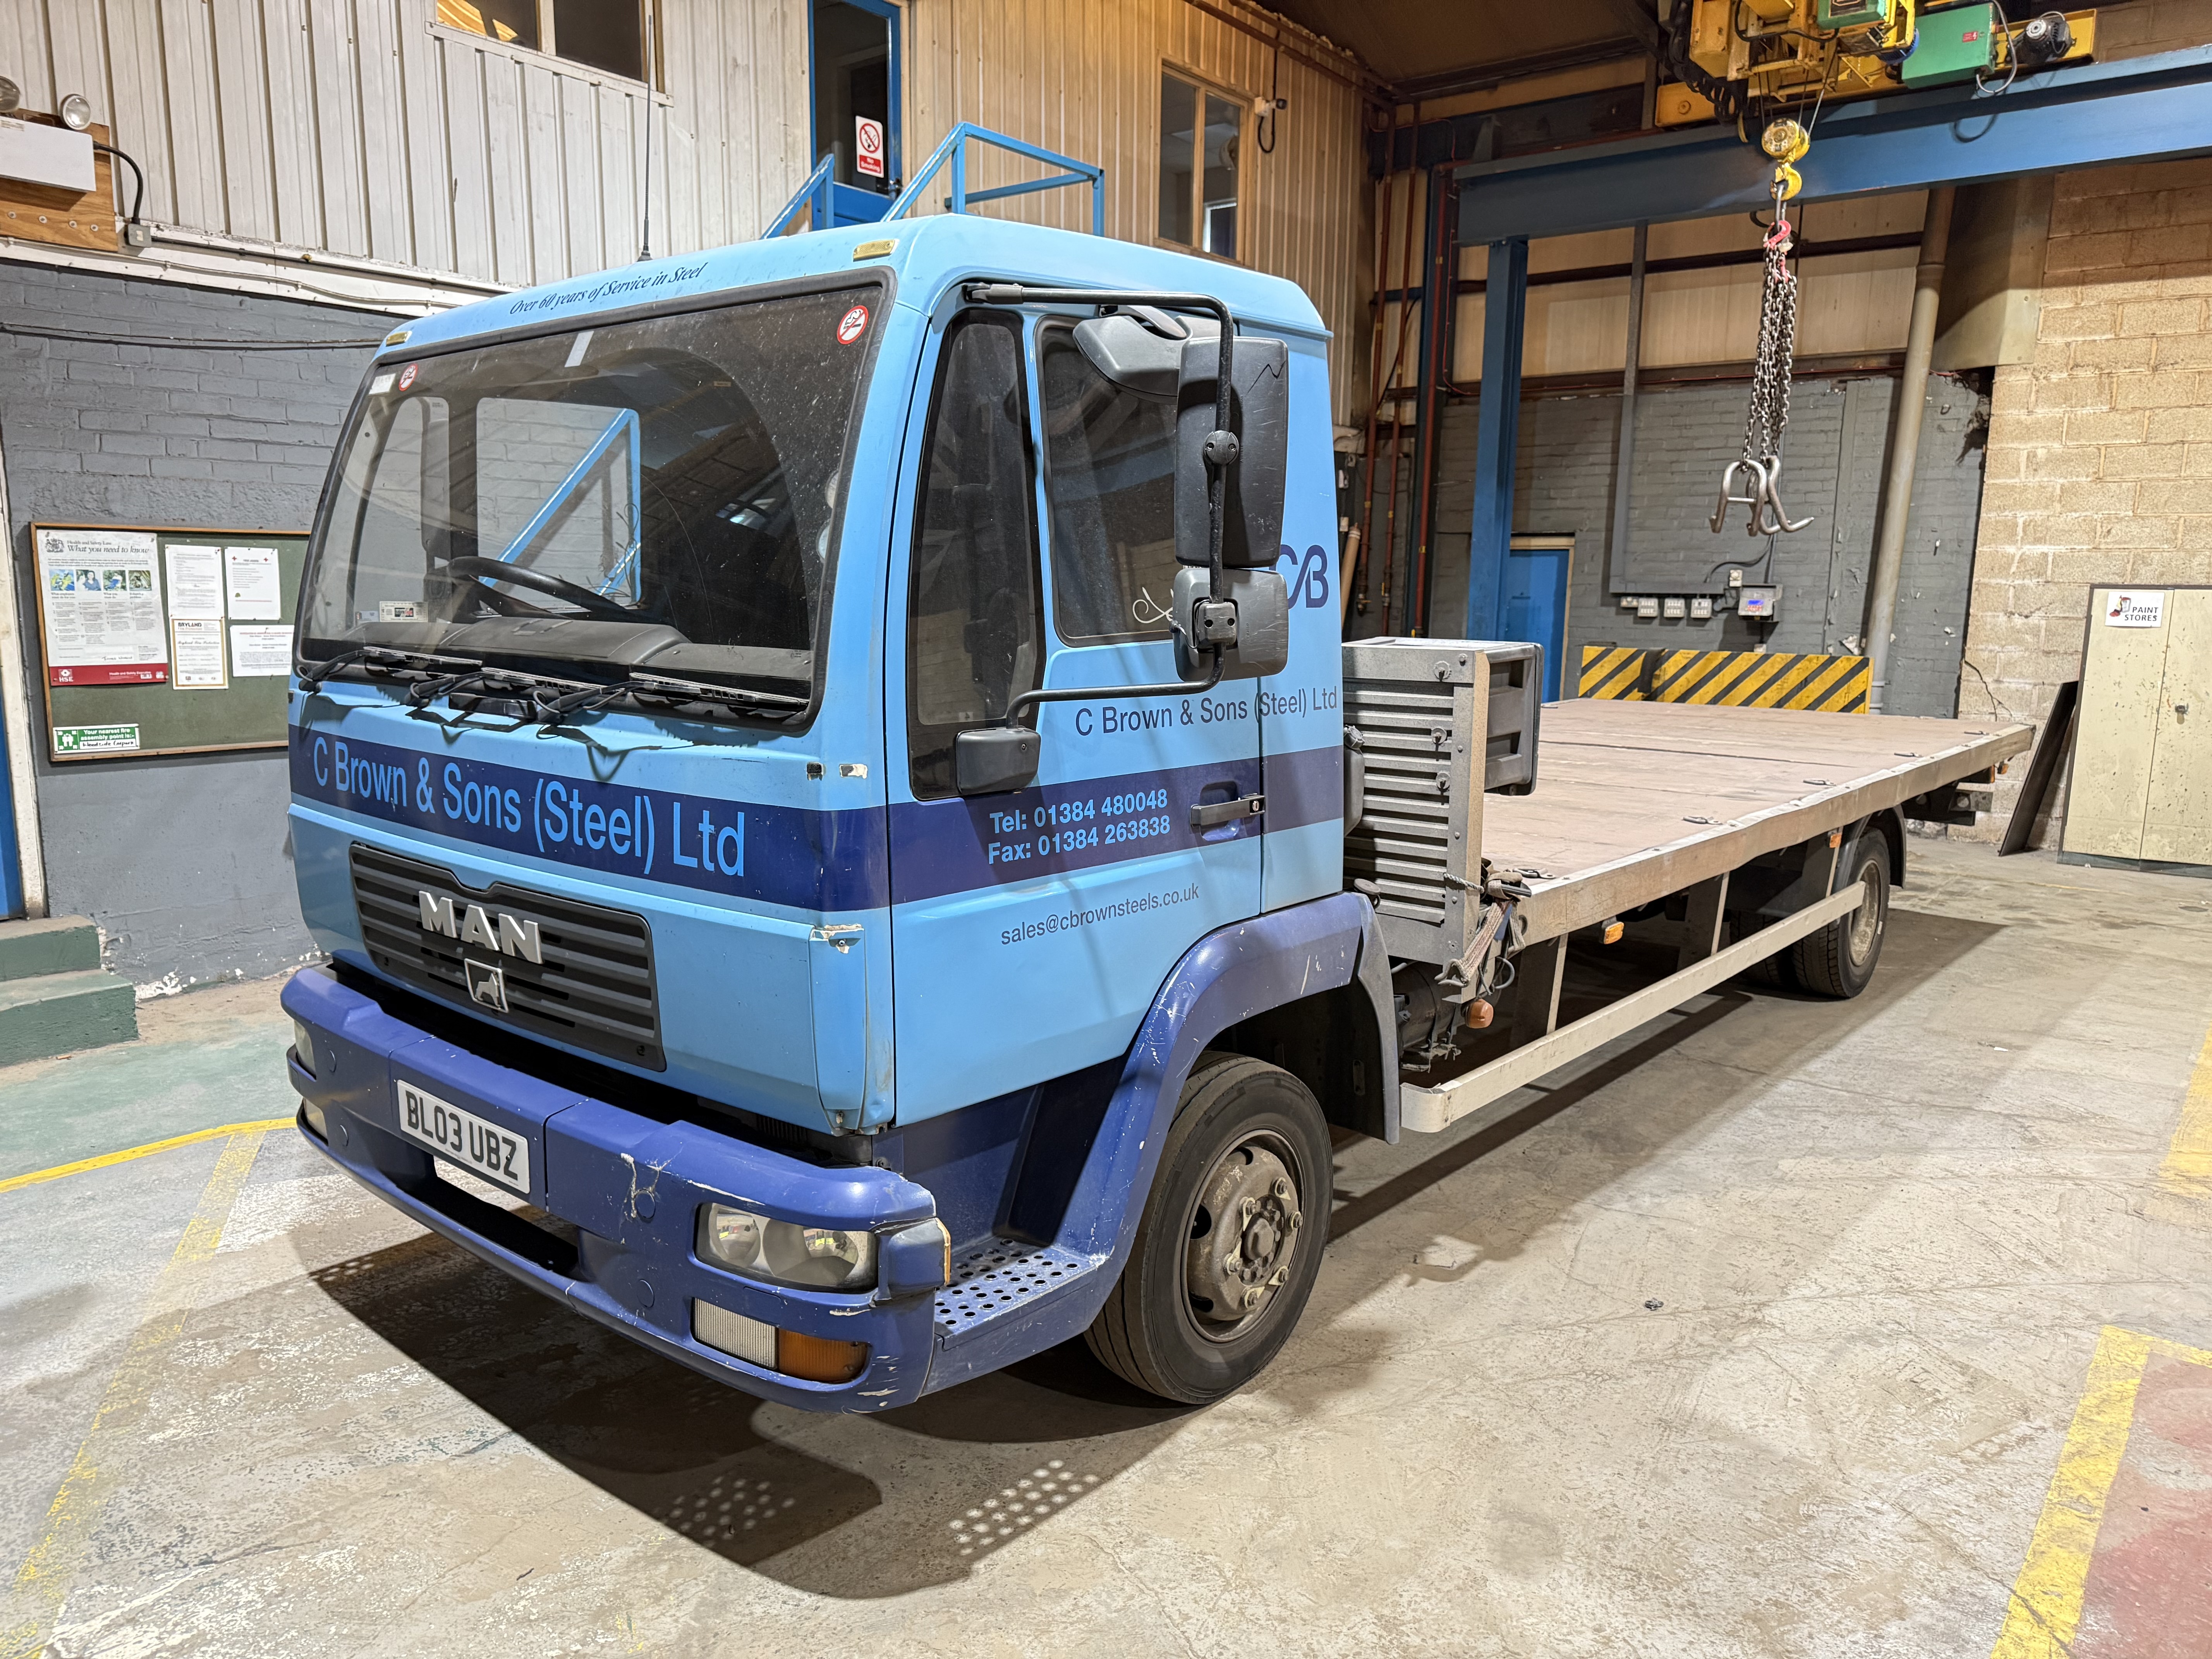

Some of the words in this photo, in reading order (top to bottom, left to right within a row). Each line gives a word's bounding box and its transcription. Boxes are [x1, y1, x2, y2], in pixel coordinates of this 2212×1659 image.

[860, 161, 880, 172] Smoking
[510, 300, 539, 314] Over
[539, 292, 557, 308] 60
[550, 289, 588, 310] years
[589, 282, 608, 303] of
[603, 275, 651, 296] Service
[652, 271, 668, 286] in
[668, 262, 709, 283] Steel
[1075, 708, 1092, 736] C
[1103, 706, 1172, 734] Brown
[1180, 699, 1194, 725] &
[1201, 697, 1247, 723] Sons
[1254, 688, 1307, 723] (Steel)
[1313, 686, 1337, 711] Ltd
[314, 737, 328, 787] C
[335, 741, 407, 807] Brown
[416, 757, 435, 814] &
[443, 762, 521, 832] Sons
[534, 778, 654, 875] (Steel)
[673, 802, 744, 877] Ltd
[989, 809, 1027, 833] Tel:
[1034, 799, 1096, 828] 01384
[1101, 789, 1168, 816] 480048
[989, 842, 1030, 865] Fax:
[1038, 827, 1099, 855] 01384
[1105, 815, 1170, 845] 263838
[419, 891, 544, 964] MAN
[1001, 883, 1199, 945] sales@cbrownsteels.co.uk
[405, 1090, 462, 1152] BL03
[469, 1121, 518, 1181] UBZ
